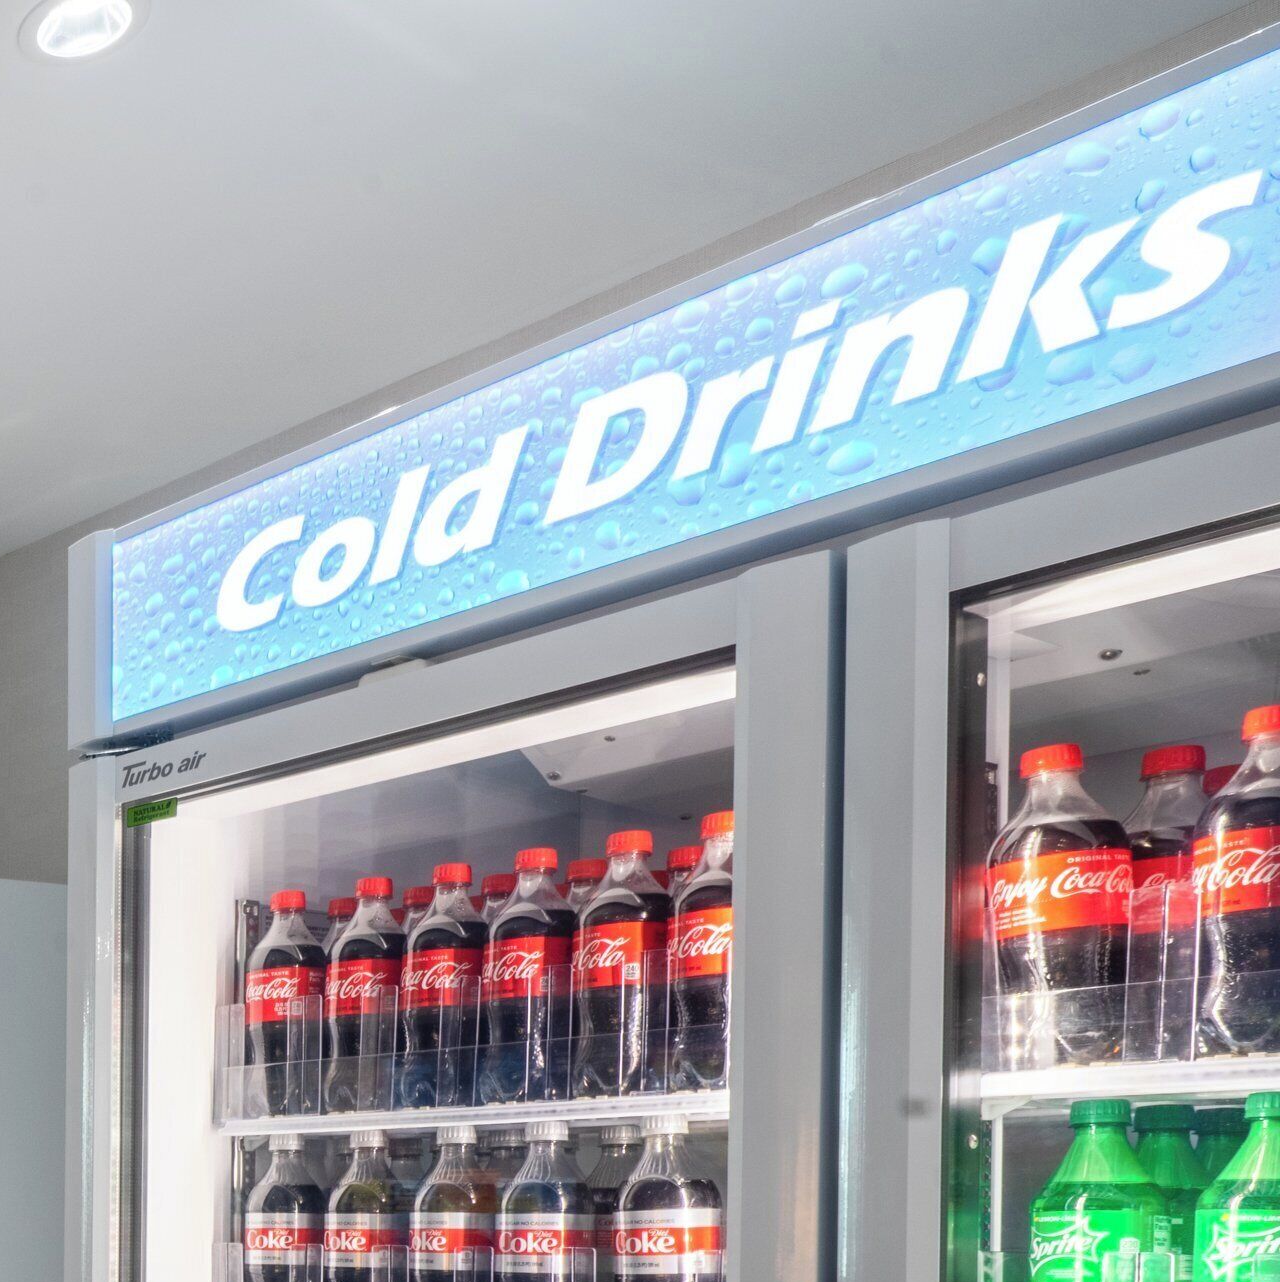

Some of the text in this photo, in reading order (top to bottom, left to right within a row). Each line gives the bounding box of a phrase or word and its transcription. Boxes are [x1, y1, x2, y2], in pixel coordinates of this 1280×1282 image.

[214, 170, 1263, 633] Cold Drinks
[122, 751, 207, 788] Turbo air
[1067, 854, 1111, 864] ORIGINAL
[990, 873, 1048, 910] Enjoy
[246, 1230, 294, 1250] Coke
[499, 1231, 559, 1254] Coke
[534, 1230, 553, 1238] Diet
[615, 1231, 675, 1255] Coke
[648, 1229, 670, 1238] Diet
